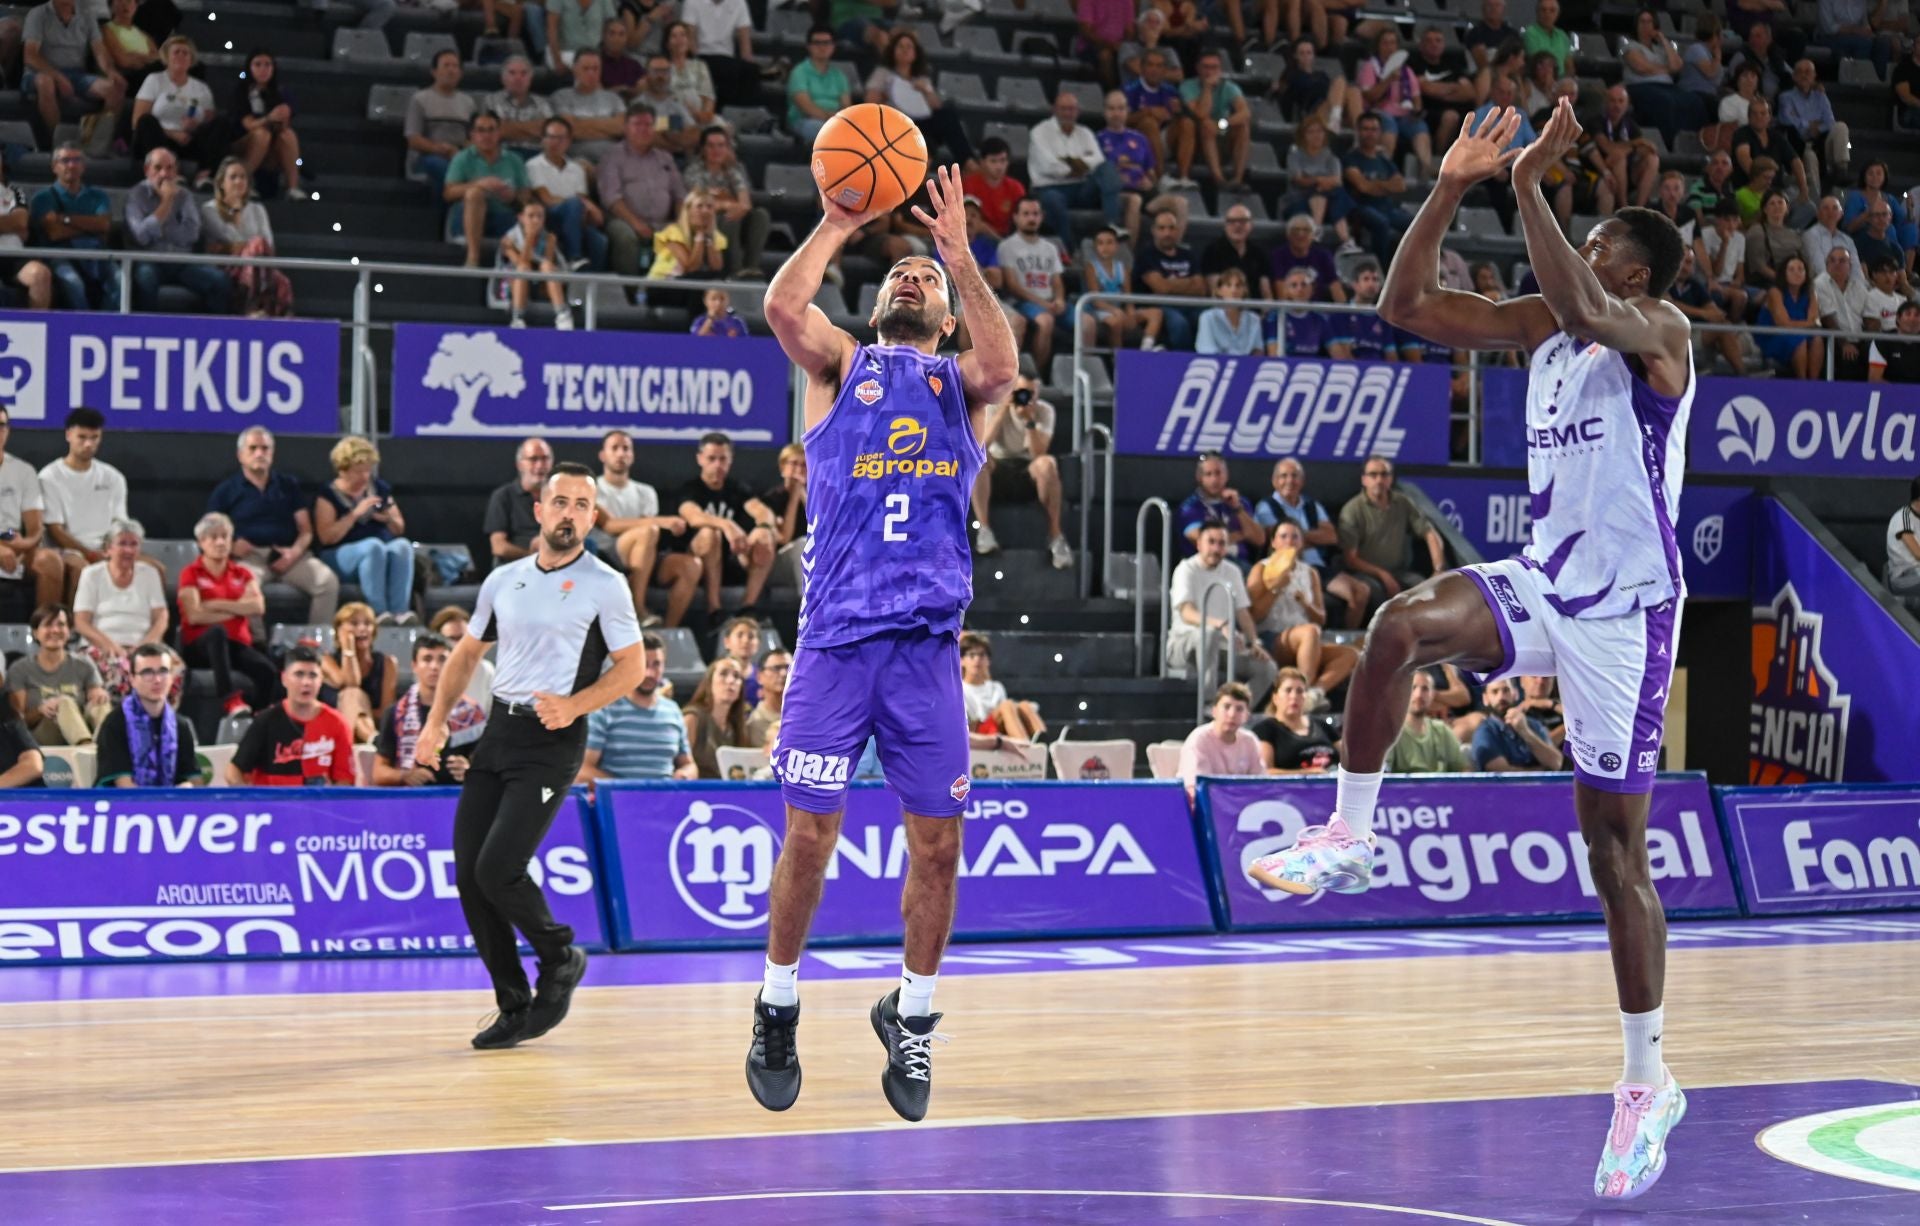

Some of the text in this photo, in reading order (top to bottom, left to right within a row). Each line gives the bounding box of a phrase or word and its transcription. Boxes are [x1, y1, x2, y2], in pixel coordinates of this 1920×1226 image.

[69, 335, 304, 415] PETKUS
[542, 362, 752, 416] TECNICAMPO
[1155, 358, 1412, 458] ALCOPAL
[1787, 391, 1917, 462] ovla
[852, 459, 959, 480] agropal
[883, 493, 910, 541] 2
[1486, 493, 1531, 543] BIE
[785, 749, 850, 784] gaza
[0, 800, 286, 855] estinver.
[963, 800, 1028, 819] UPO
[1372, 805, 1454, 836] uper
[295, 830, 426, 852] consultores
[156, 883, 293, 905] ARQUITECTURA
[297, 846, 593, 903] MODS
[311, 935, 523, 952] INGENIER
